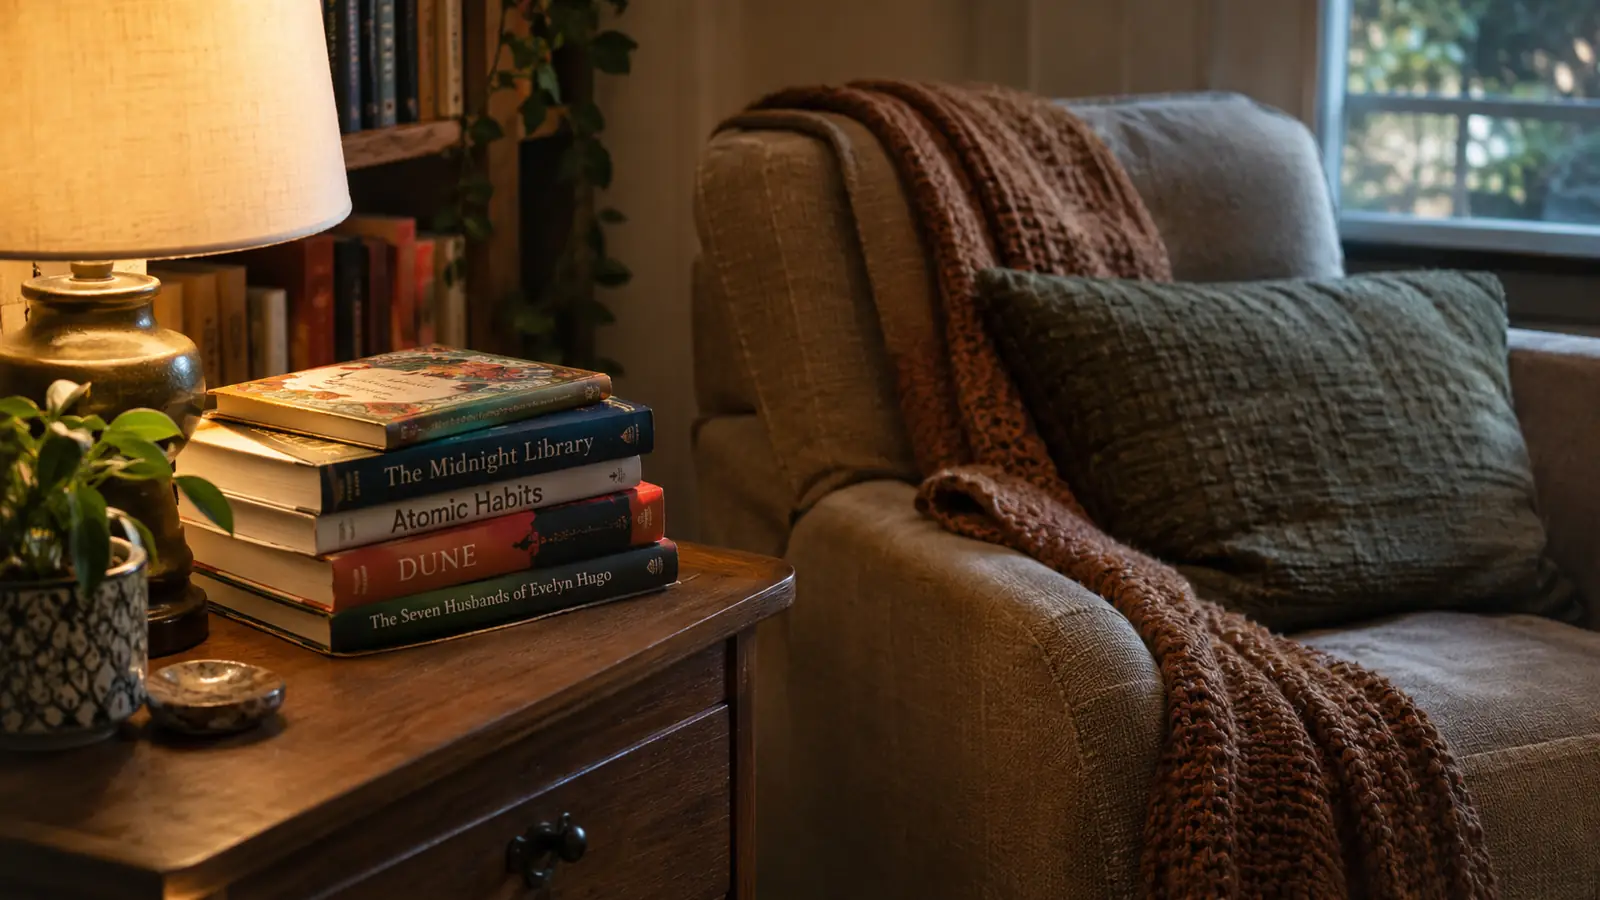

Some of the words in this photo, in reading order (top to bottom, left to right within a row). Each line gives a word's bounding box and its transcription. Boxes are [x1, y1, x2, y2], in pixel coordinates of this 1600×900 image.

[385, 465, 422, 487] The
[430, 447, 517, 478] Midnight
[525, 436, 594, 462] Library
[392, 498, 469, 533] Atomic
[475, 485, 543, 515] Habits
[399, 544, 477, 581] DUNE
[370, 613, 397, 629] The
[401, 606, 441, 624] Seven
[444, 589, 510, 615] Husbands
[513, 586, 527, 602] of
[530, 577, 573, 598] Evelyn
[577, 570, 612, 588] Hugo
